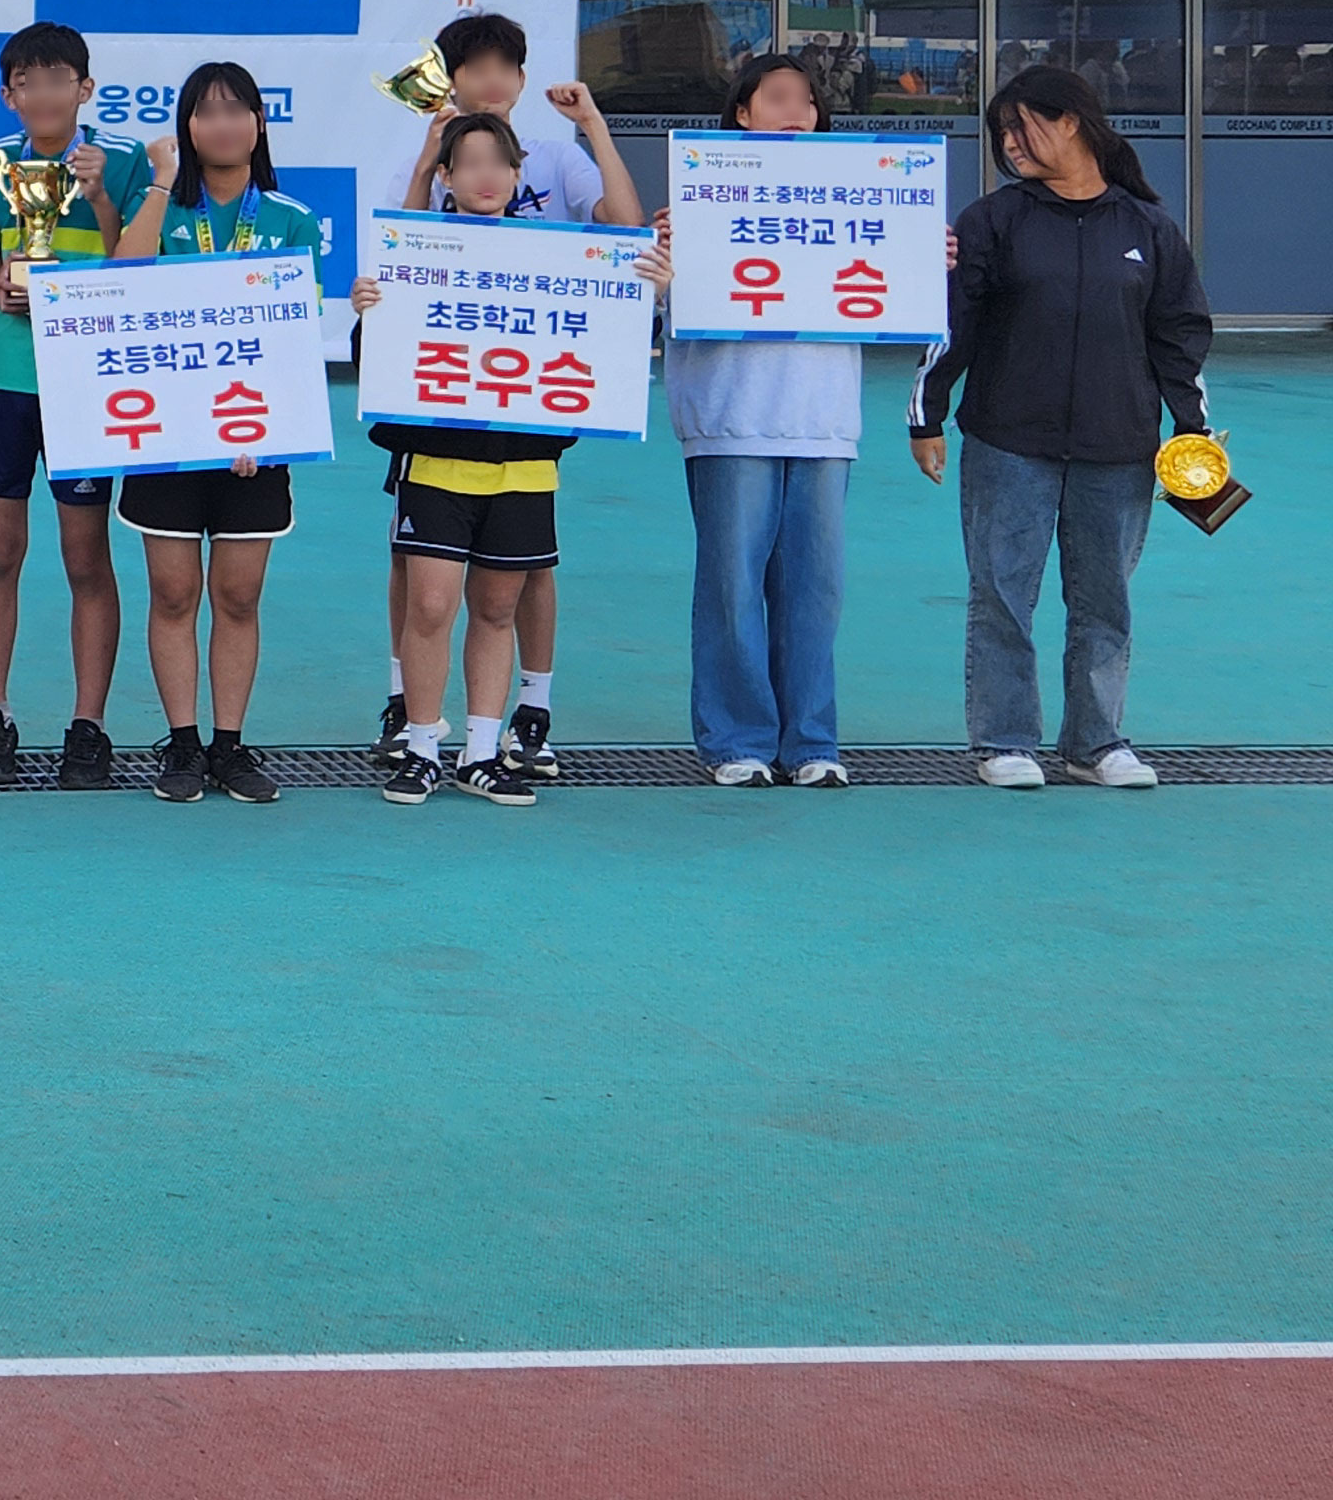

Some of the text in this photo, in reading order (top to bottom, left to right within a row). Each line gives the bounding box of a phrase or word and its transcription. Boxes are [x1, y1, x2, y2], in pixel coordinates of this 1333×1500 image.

[96, 86, 294, 125] 웅양교
[867, 120, 912, 130] COMPLEX
[1227, 120, 1277, 131] GEOCHANG
[1281, 120, 1323, 131] COMPLEX
[681, 185, 748, 202] 교육장배
[833, 187, 934, 205] 육상경기대회
[731, 217, 885, 245] 초등학교 1부
[377, 265, 448, 287] 교육장배
[535, 274, 643, 300] 육상경기대회
[731, 258, 887, 318] 우 승
[45, 315, 115, 337] 교육장배
[202, 302, 307, 325] 육상경기대회
[426, 301, 587, 338] 초등학교 1부
[98, 338, 263, 375] 초등학교 2부
[413, 341, 595, 414] 준우승
[105, 381, 268, 450] 우 승
